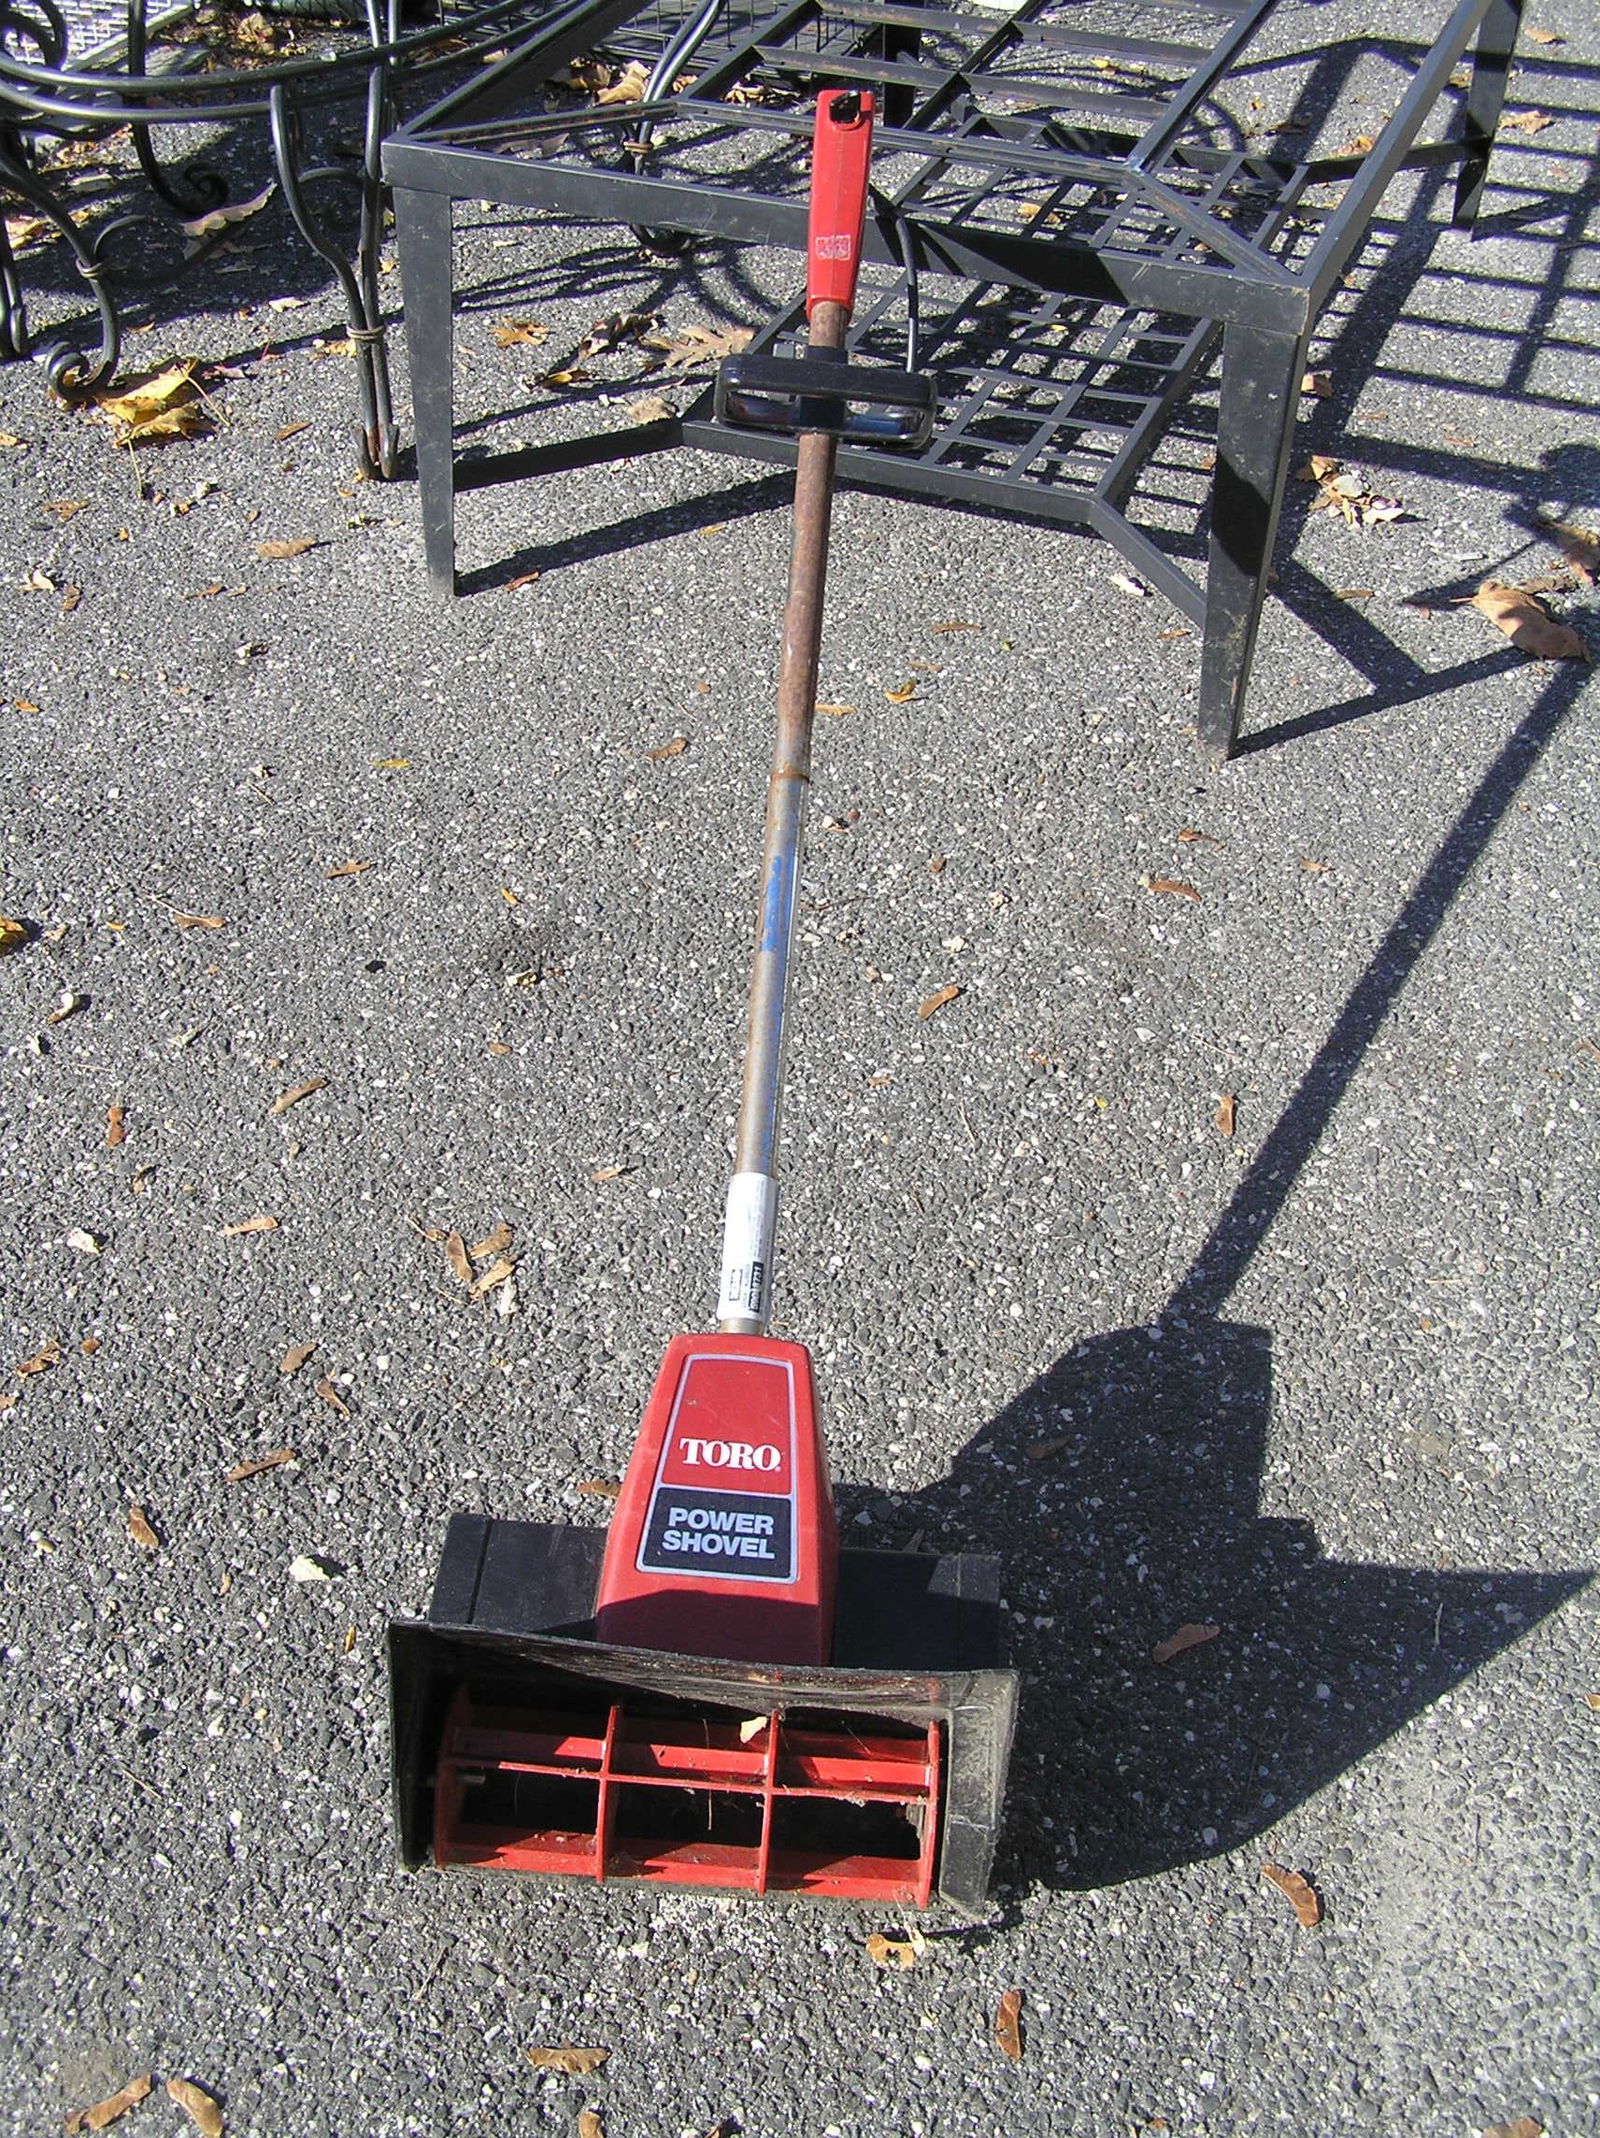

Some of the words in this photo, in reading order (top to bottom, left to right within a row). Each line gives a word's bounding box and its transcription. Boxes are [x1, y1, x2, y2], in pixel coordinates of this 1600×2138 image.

[680, 1438, 782, 1471] TORO
[668, 1507, 774, 1535] POWER
[661, 1530, 775, 1559] SHOVEL
